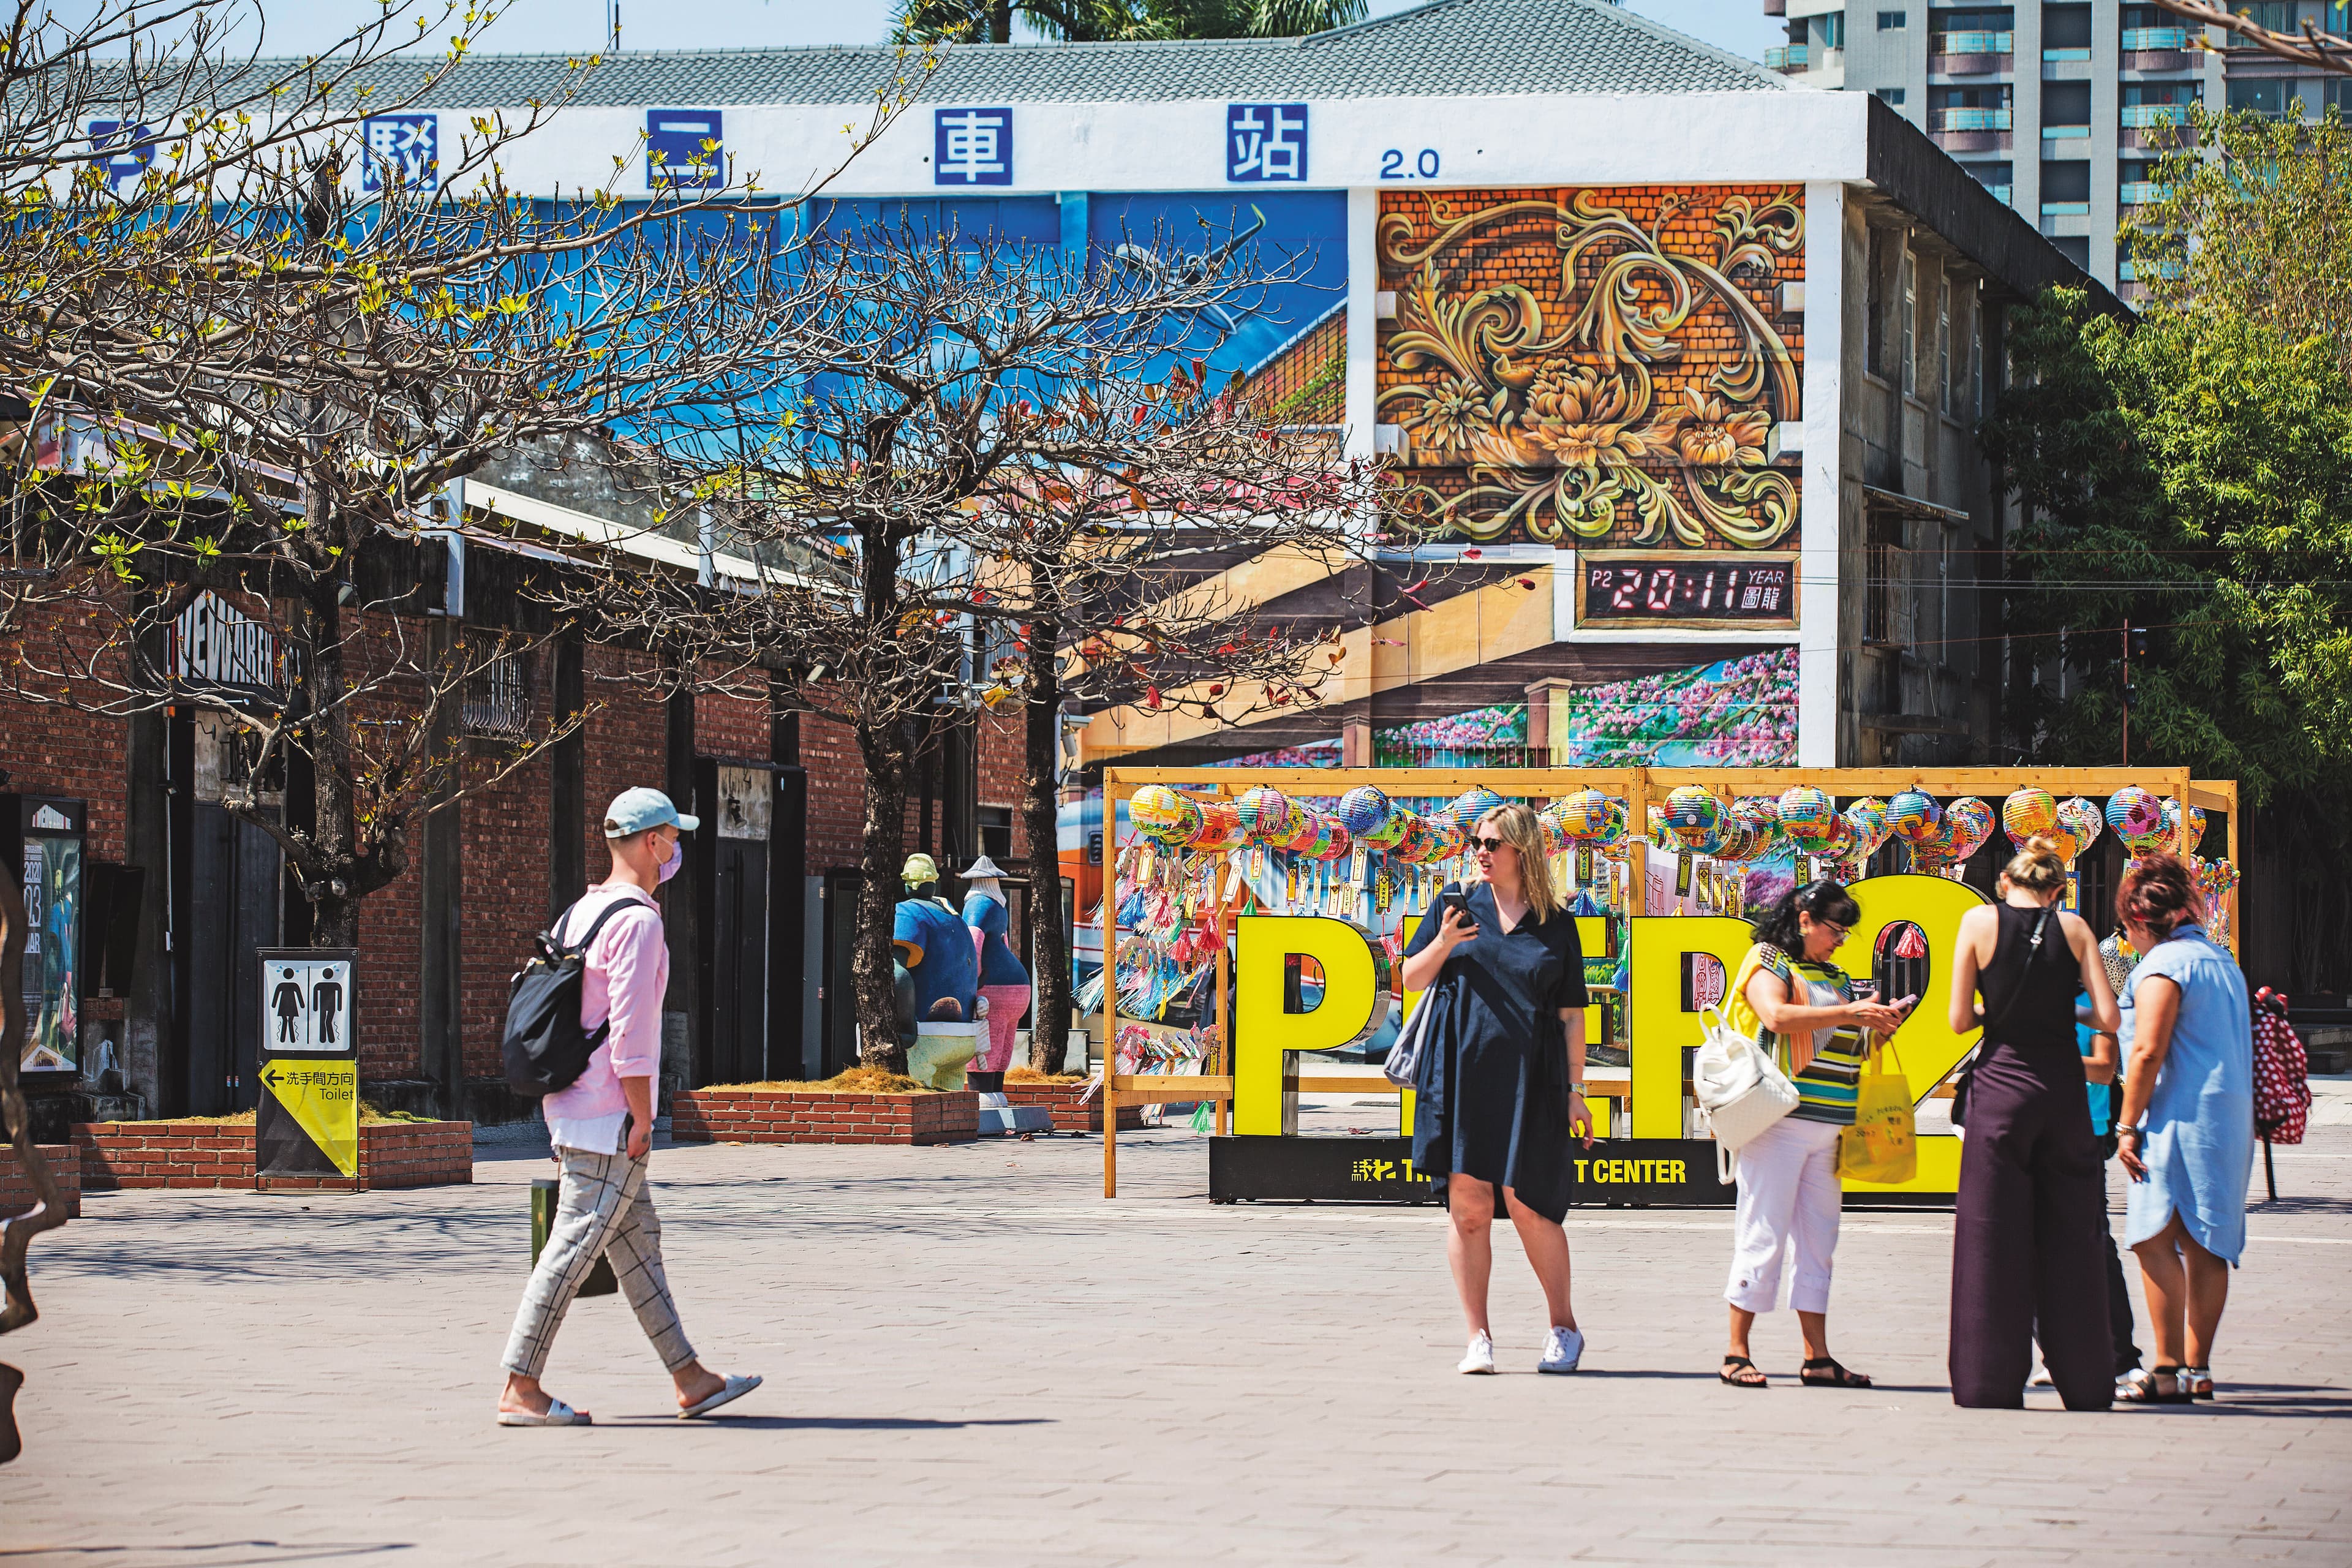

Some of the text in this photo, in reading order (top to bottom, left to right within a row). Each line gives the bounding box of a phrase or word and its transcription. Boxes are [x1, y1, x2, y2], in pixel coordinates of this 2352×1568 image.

[364, 118, 436, 190] 駁
[940, 111, 1006, 182] 車
[1232, 107, 1304, 179] 站
[1381, 149, 1439, 179] 2.0
[1591, 568, 1785, 609] P2 20:11 YEAR
[24, 861, 42, 883] 2020
[286, 1071, 353, 1085] 洗手間方向
[320, 1088, 353, 1100] Toilet
[1593, 1159, 1686, 1184] CENTER
